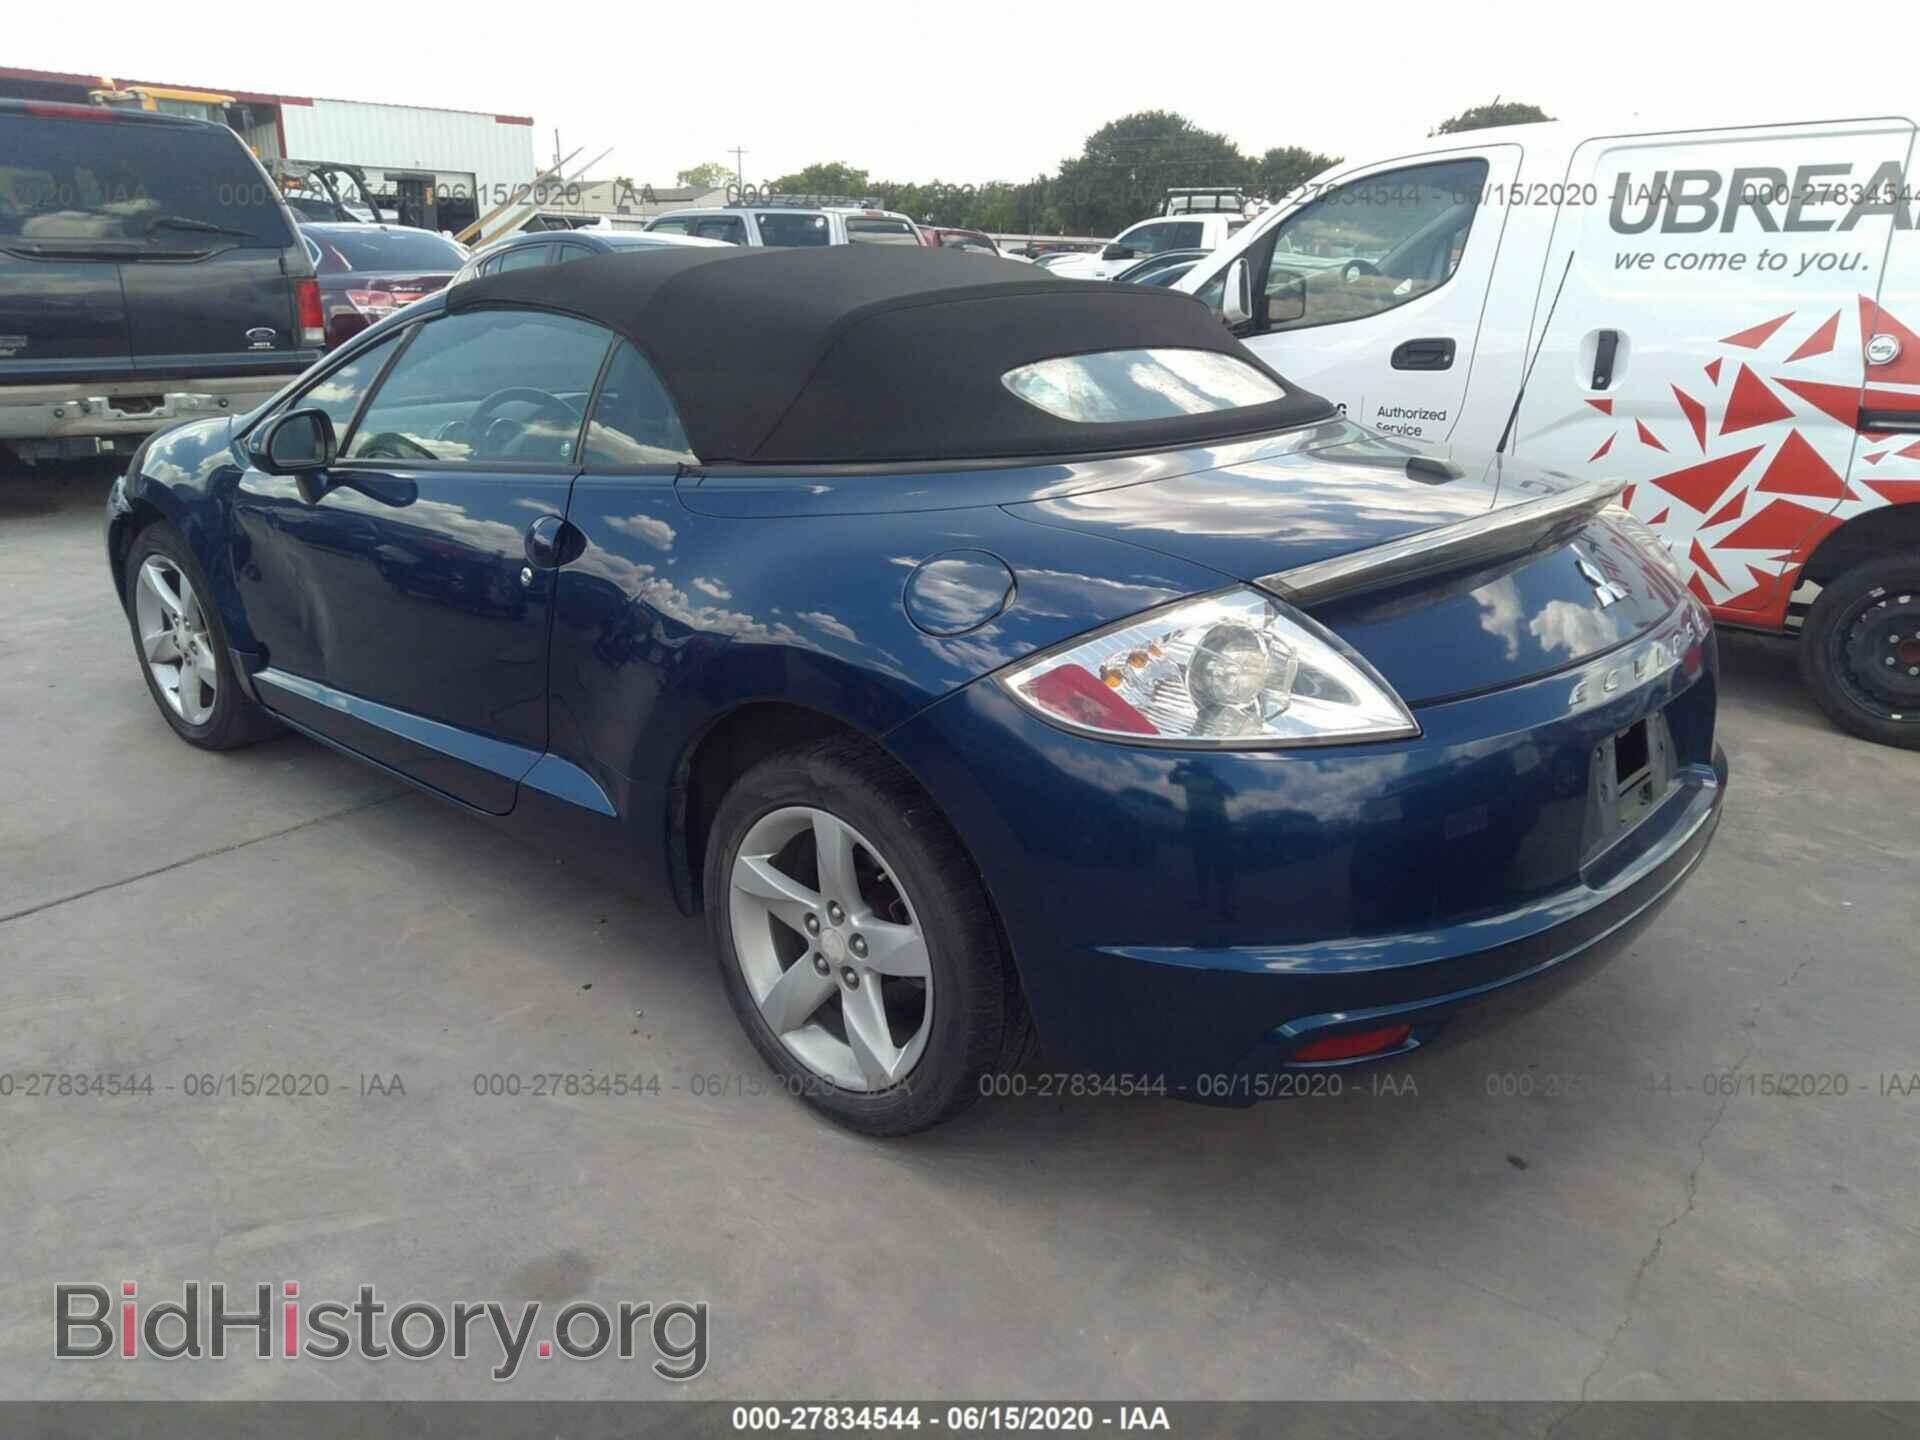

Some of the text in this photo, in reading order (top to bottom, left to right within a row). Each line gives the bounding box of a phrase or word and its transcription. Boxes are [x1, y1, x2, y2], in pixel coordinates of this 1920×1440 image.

[1609, 161, 1920, 234] UBREA
[1614, 249, 1869, 278] we come to you.
[1377, 405, 1447, 421] Authorized
